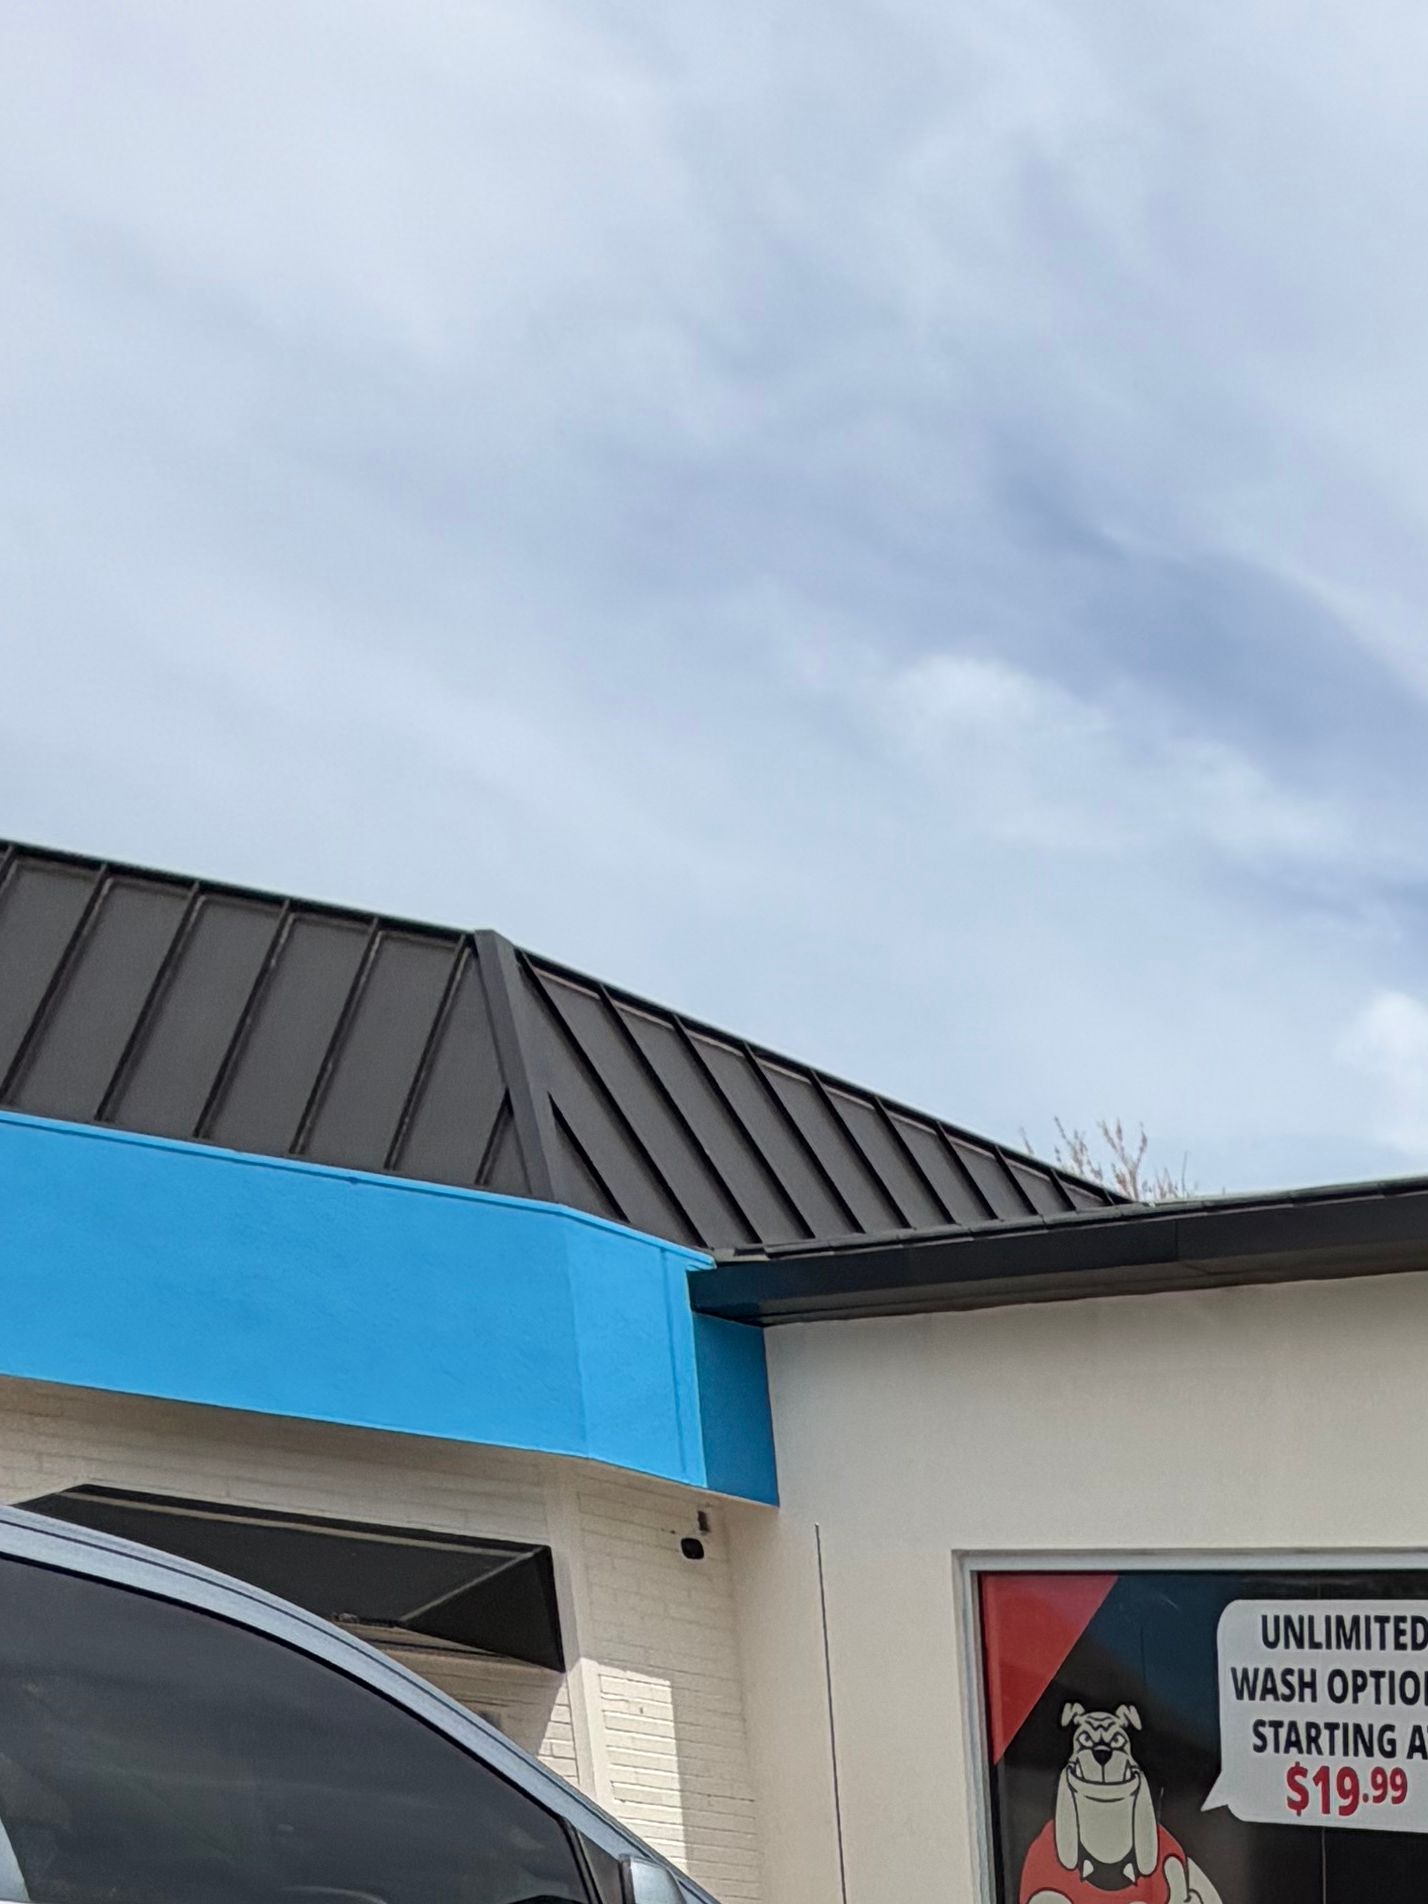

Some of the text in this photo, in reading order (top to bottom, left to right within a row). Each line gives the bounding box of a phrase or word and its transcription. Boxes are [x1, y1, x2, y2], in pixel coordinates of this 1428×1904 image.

[1230, 1667, 1317, 1703] WASH
[1252, 1719, 1397, 1759] STARTING
[1286, 1761, 1408, 1817] $19.99
